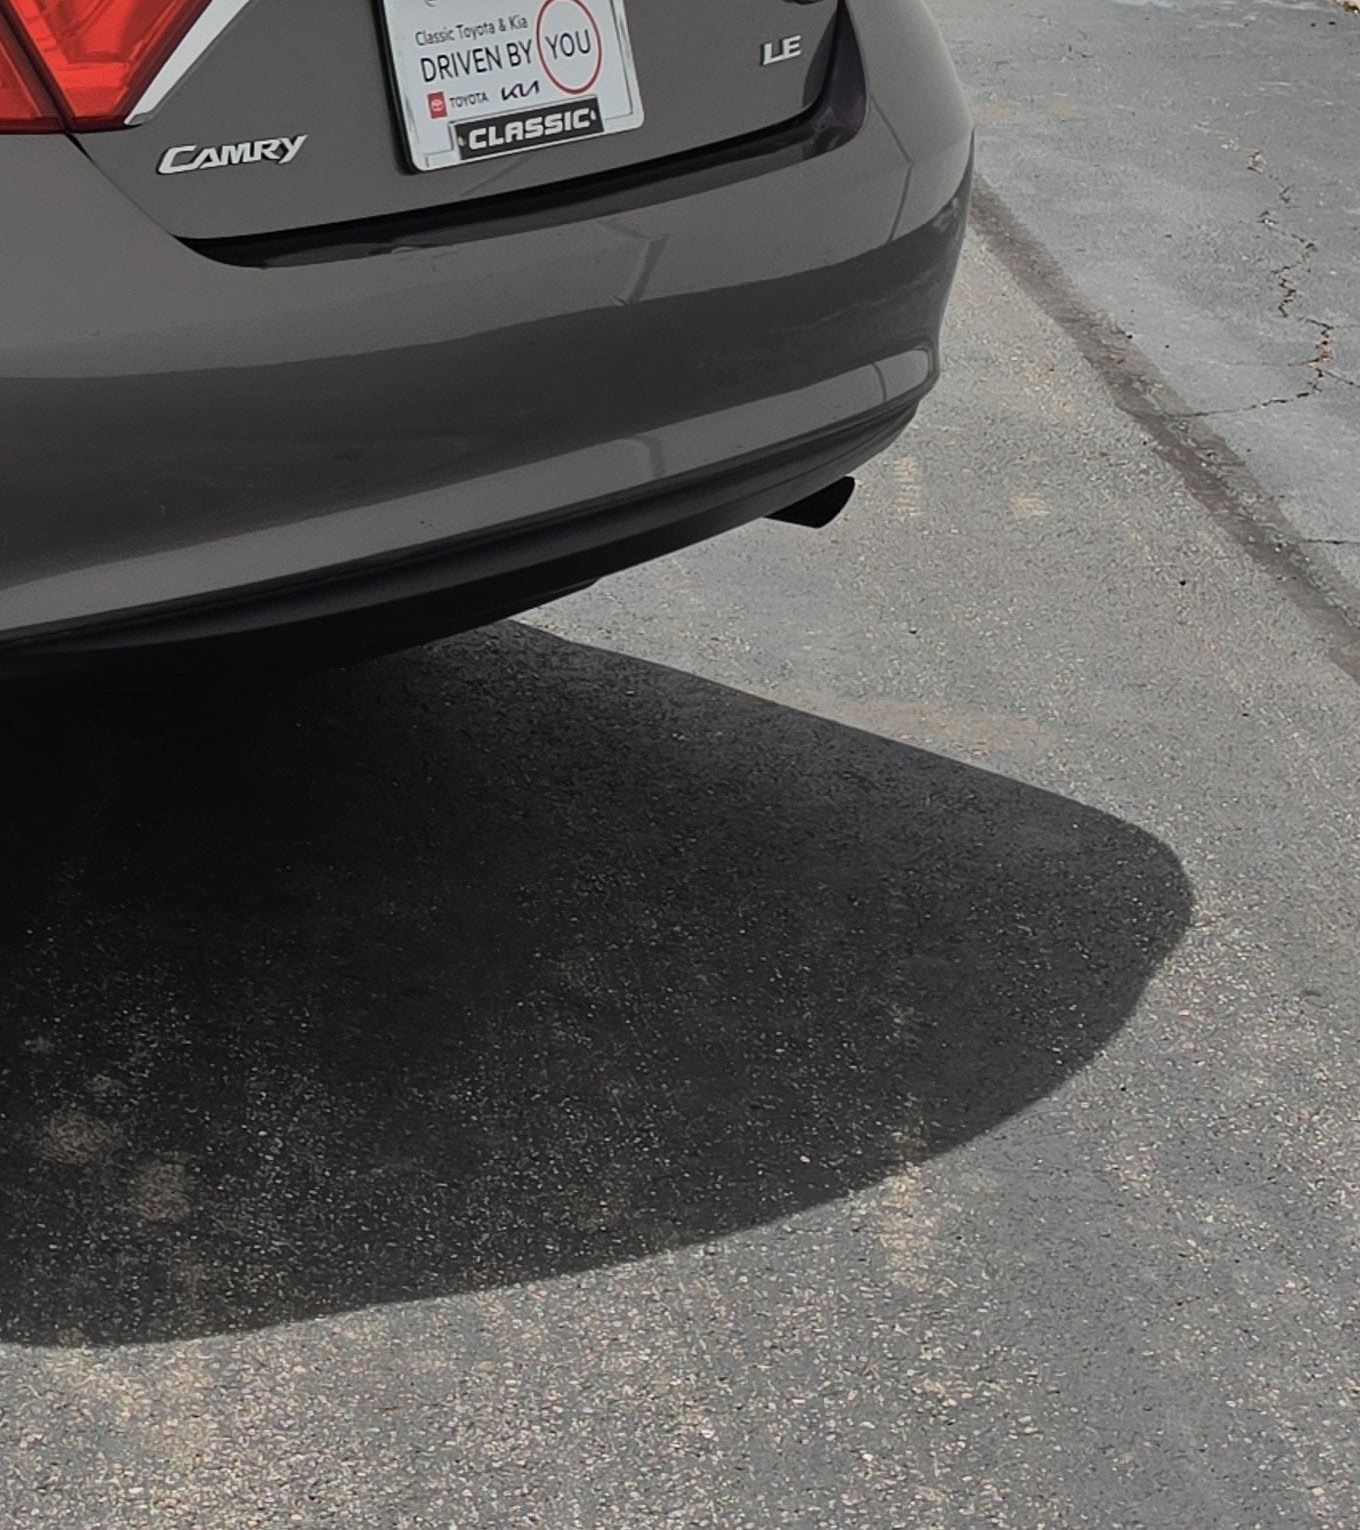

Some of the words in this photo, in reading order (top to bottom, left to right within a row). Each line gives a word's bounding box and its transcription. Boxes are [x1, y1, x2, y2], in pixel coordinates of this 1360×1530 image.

[415, 27, 455, 46] Classic
[455, 22, 495, 40] Toyota
[498, 18, 506, 32] &
[509, 14, 528, 30] Kia
[420, 44, 503, 82] DRIVEN
[506, 39, 532, 67] BY
[545, 29, 592, 59] YOU
[762, 34, 802, 66] LE
[449, 92, 489, 108] TOYOTA
[468, 107, 591, 150] CLASSIC
[158, 134, 308, 174] CAMRY
